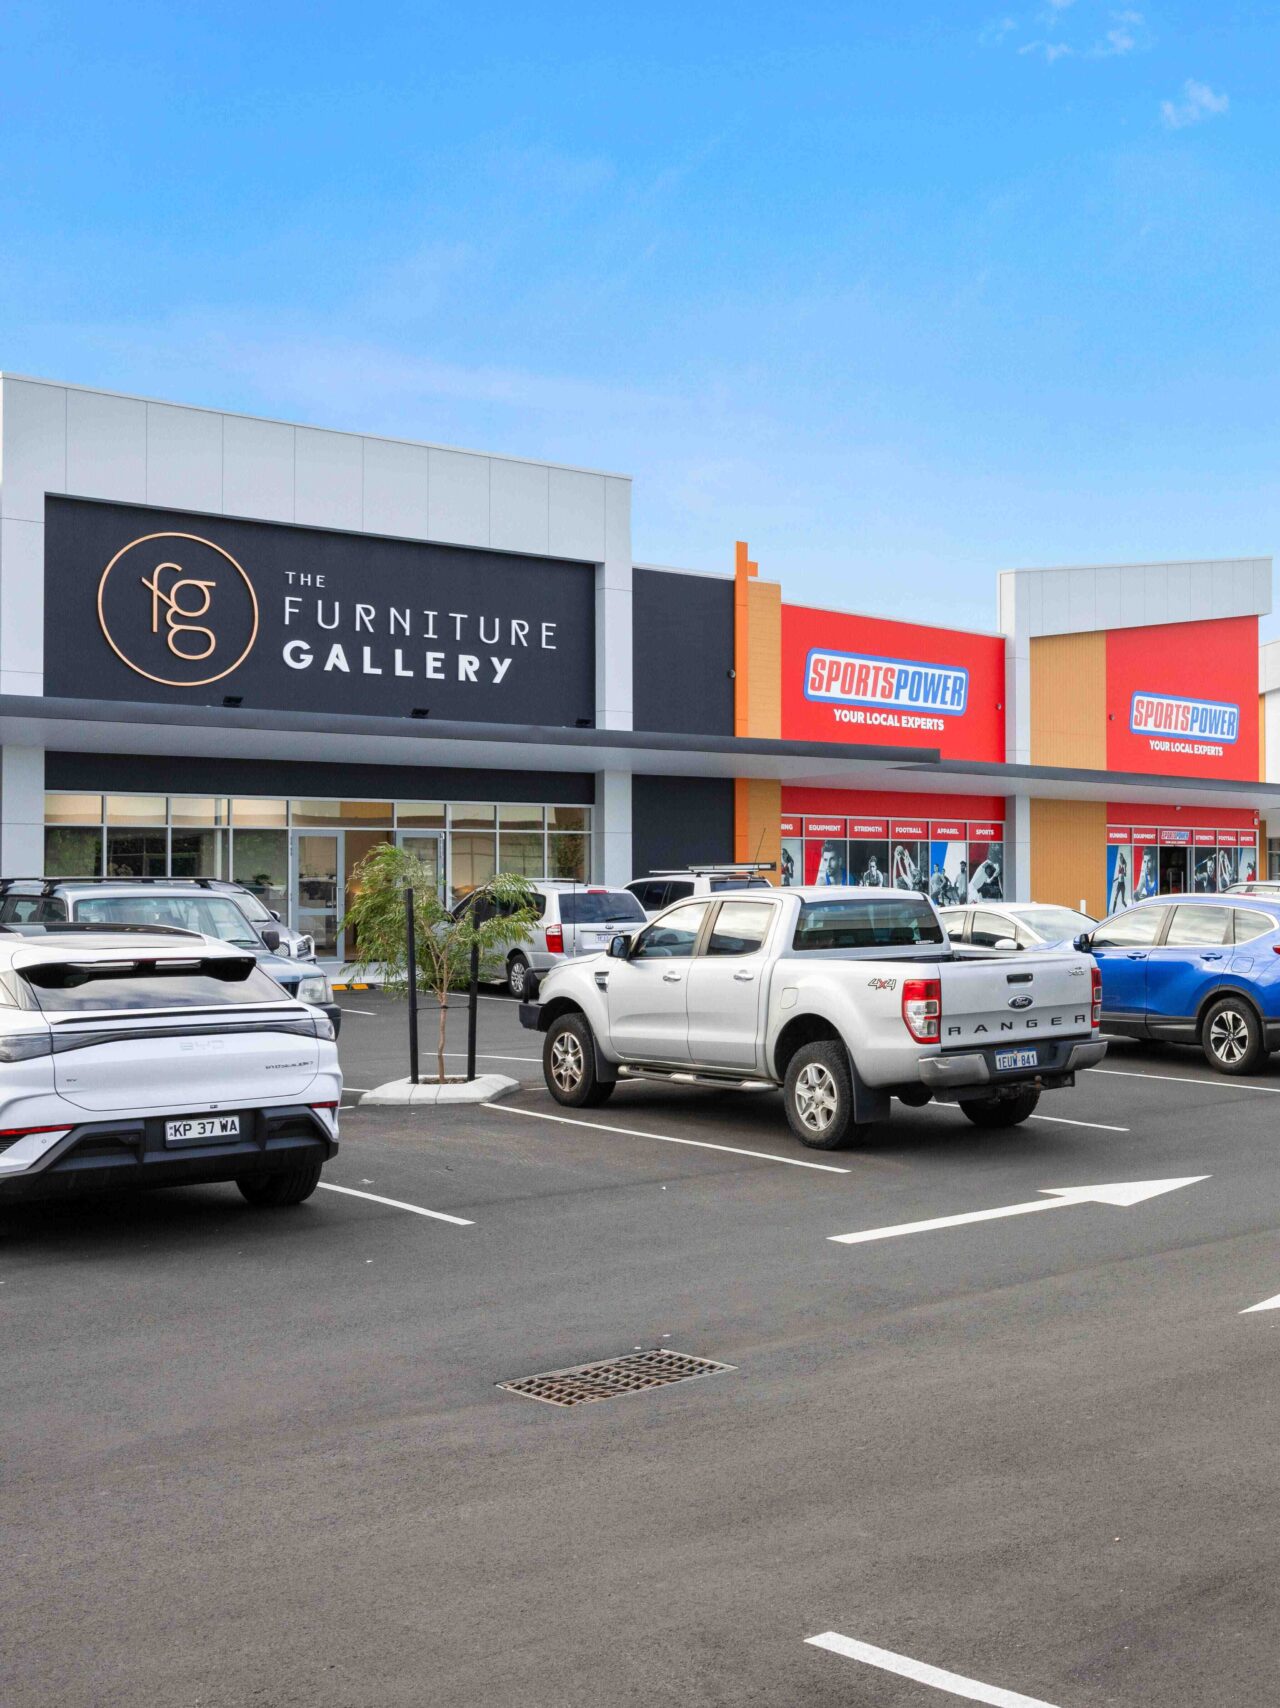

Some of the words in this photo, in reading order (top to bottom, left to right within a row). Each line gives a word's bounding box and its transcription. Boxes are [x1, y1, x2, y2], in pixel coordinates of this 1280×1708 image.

[285, 571, 326, 588] THE
[284, 596, 557, 649] FURNITURE
[282, 639, 512, 684] GALLERY
[809, 658, 965, 707] SPORTSPOWER
[833, 709, 865, 724] YOUR
[866, 713, 900, 727] LOCAL
[901, 715, 945, 731] EXPERTS
[1133, 699, 1237, 737] SPORTSPOWER
[1149, 740, 1171, 751] YOUR
[1171, 742, 1193, 754] LOCAL
[1194, 744, 1224, 756] EXPERTS
[808, 824, 841, 832] EQUIPMENT
[853, 825, 883, 833] STRENGTH
[895, 826, 922, 834] FOOTBALL
[936, 827, 959, 835] APPAREL
[948, 1014, 1086, 1036] RANGER
[173, 1123, 192, 1138] KP
[197, 1121, 215, 1135] 37
[220, 1119, 238, 1134] WA
